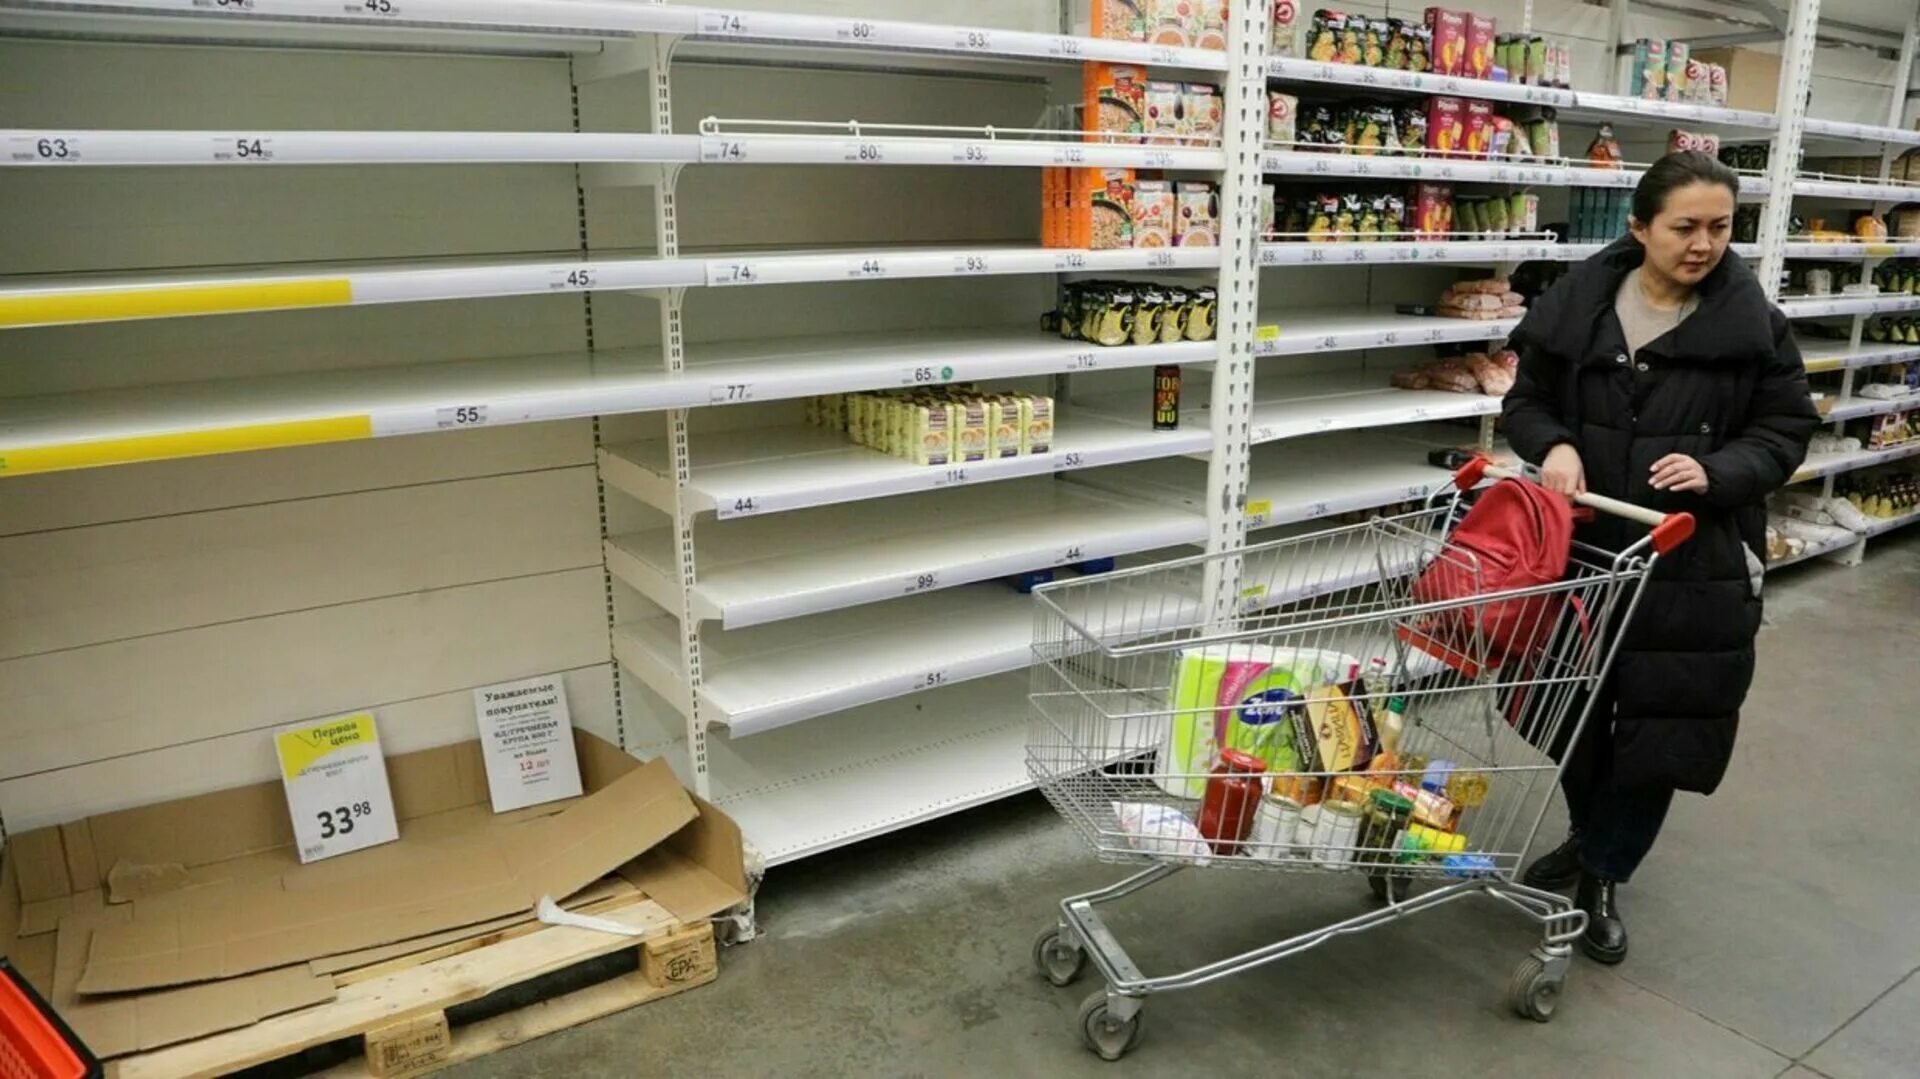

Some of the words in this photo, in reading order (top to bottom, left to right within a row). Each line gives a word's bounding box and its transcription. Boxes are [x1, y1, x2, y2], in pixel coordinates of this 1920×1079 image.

[720, 14, 741, 31] 74
[852, 23, 869, 38] 80
[968, 32, 985, 48] 93
[36, 138, 69, 158] 63
[236, 139, 263, 157] 54
[719, 142, 740, 158] 74
[859, 144, 878, 160] 80
[966, 146, 983, 161] 93
[861, 259, 880, 273] 44
[966, 256, 984, 271] 93
[567, 270, 590, 286] 45
[730, 265, 751, 280] 74
[915, 368, 932, 382] 65
[727, 384, 746, 400] 77
[456, 406, 480, 424] 55
[1065, 452, 1080, 466] 53
[734, 496, 753, 513] 44
[1065, 547, 1081, 560] 44
[917, 574, 934, 590] 99
[926, 673, 942, 686] 51
[484, 683, 555, 703] Уважаемые
[486, 695, 559, 715] покупатели!
[312, 721, 358, 741] Первая
[330, 731, 361, 747] цена
[520, 761, 533, 772] 12
[317, 806, 354, 839] 33
[353, 801, 372, 818] 98
